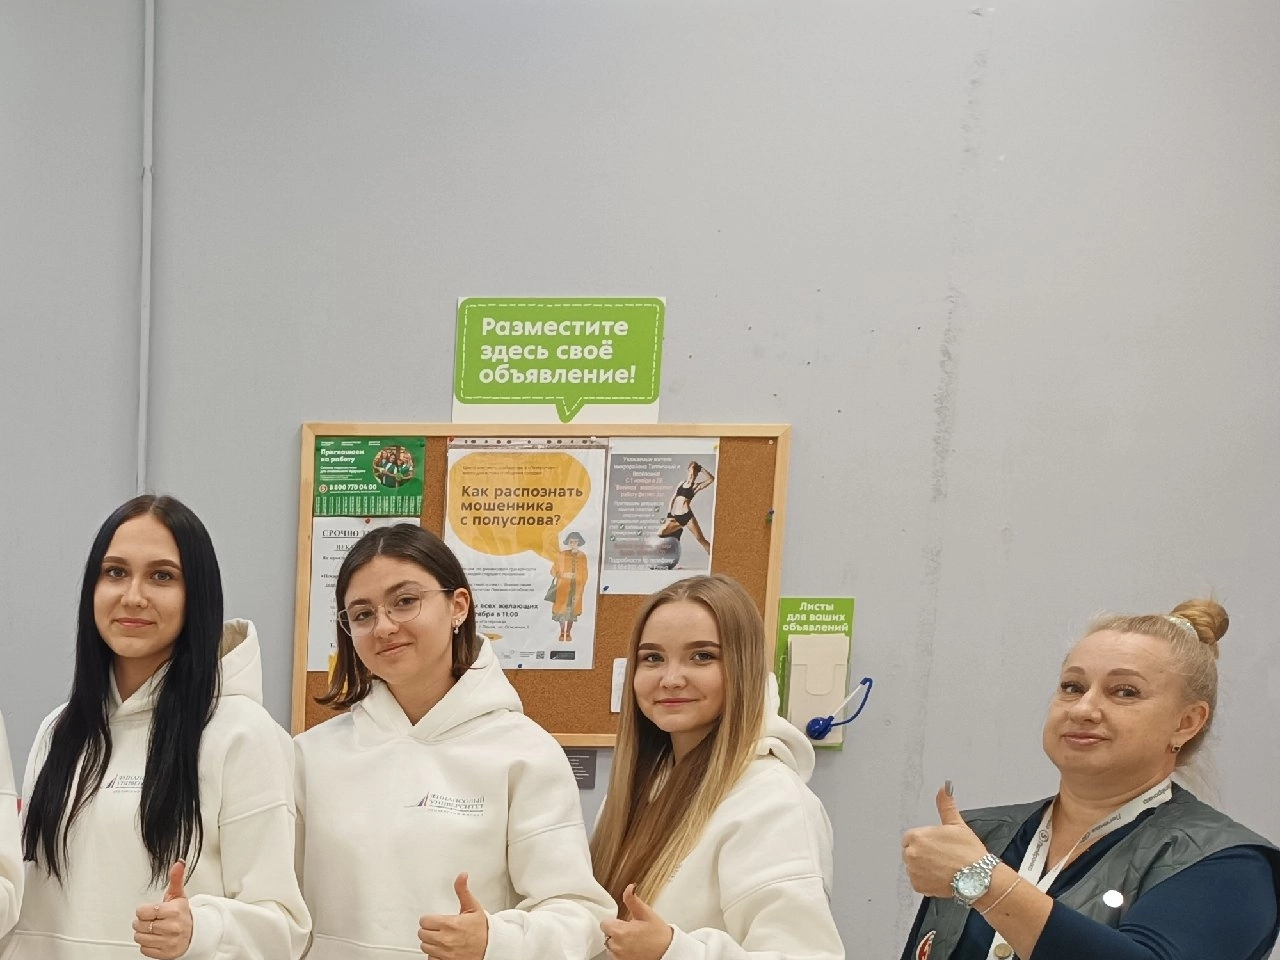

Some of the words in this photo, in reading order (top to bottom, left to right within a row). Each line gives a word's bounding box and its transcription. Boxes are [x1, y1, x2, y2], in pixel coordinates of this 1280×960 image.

[482, 317, 629, 336] Разместите
[481, 344, 549, 362] здесь
[556, 340, 613, 360] своё
[479, 364, 637, 384] объявление!
[461, 486, 489, 497] Как
[494, 486, 583, 500] распознать
[460, 501, 554, 512] мошенника
[460, 516, 468, 526] с
[473, 515, 562, 528] полуслова?
[798, 602, 834, 611] Листы
[786, 613, 807, 621] для
[809, 613, 846, 621] ваших
[782, 622, 849, 632] объявлений
